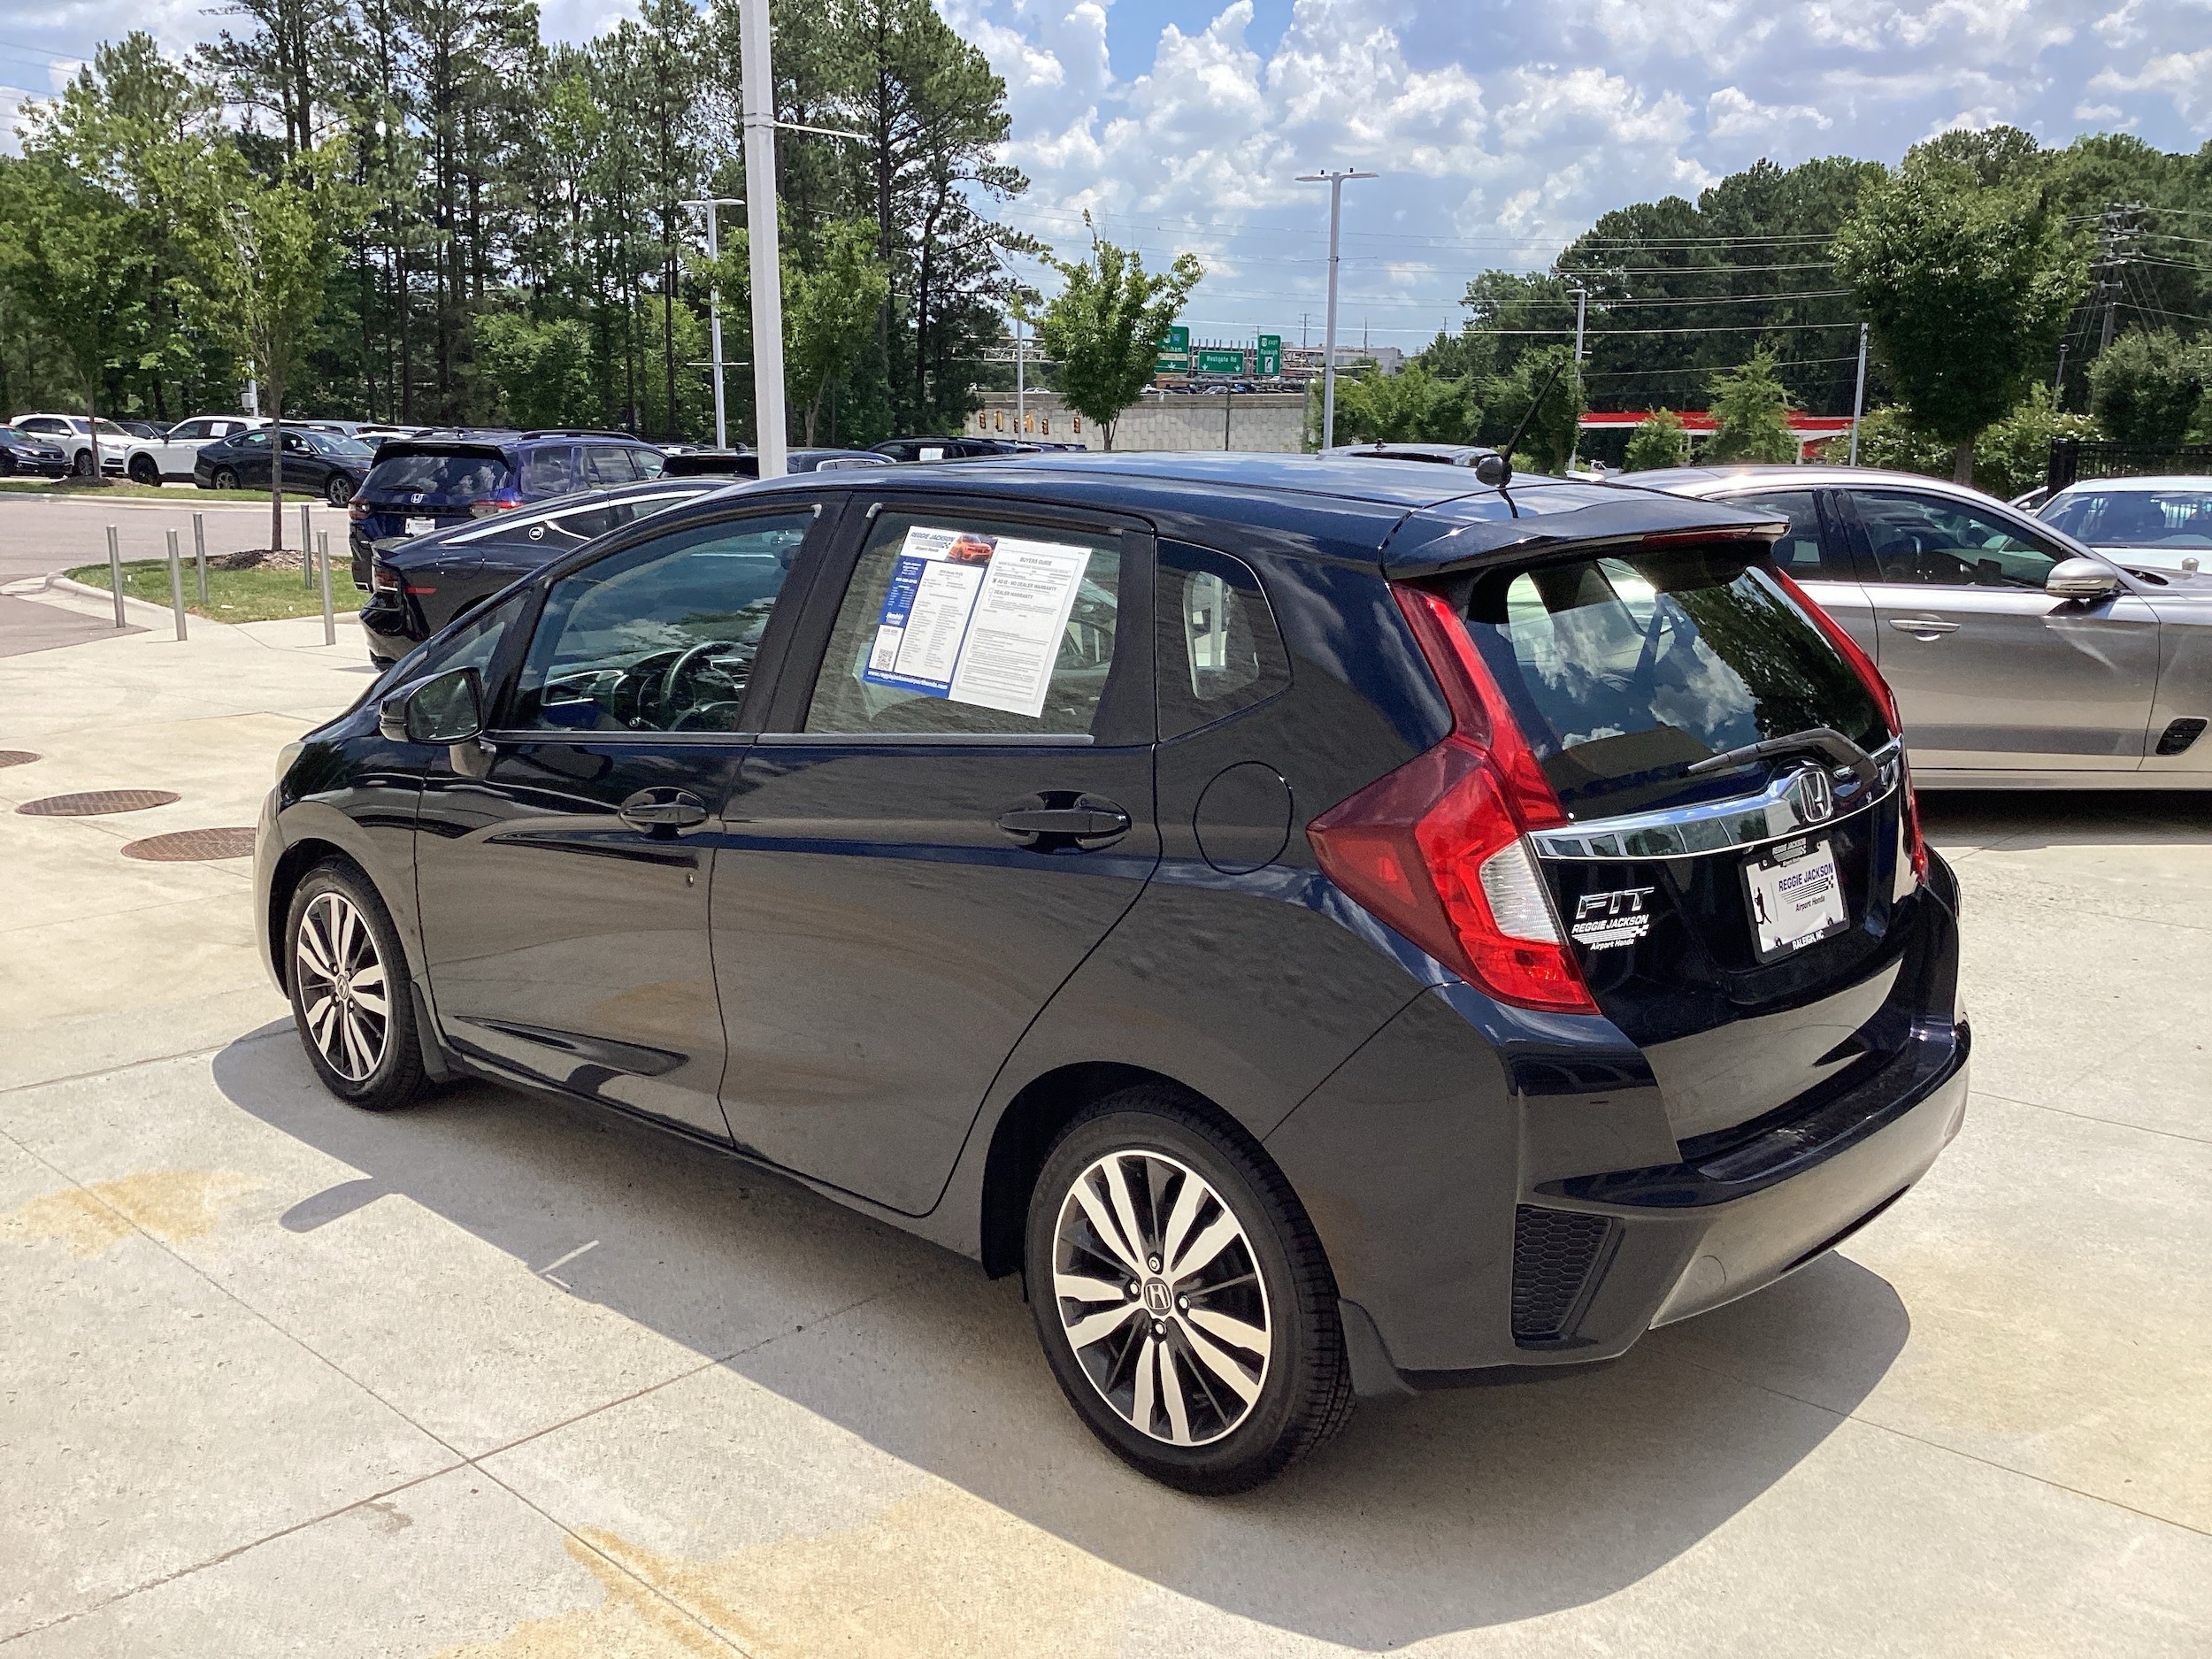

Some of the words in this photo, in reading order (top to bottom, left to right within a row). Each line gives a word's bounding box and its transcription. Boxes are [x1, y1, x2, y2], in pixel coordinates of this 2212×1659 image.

[1778, 873, 1802, 893] REGGIE
[1803, 863, 1833, 883] JACKSON
[1575, 887, 1655, 919] FIT
[1795, 900, 1811, 912] Airport
[1811, 895, 1825, 906] Honda
[1571, 919, 1608, 933] REGGIE
[1606, 914, 1649, 929] JACKSON
[1815, 930, 1824, 941] NC
[1590, 941, 1615, 950] Airport
